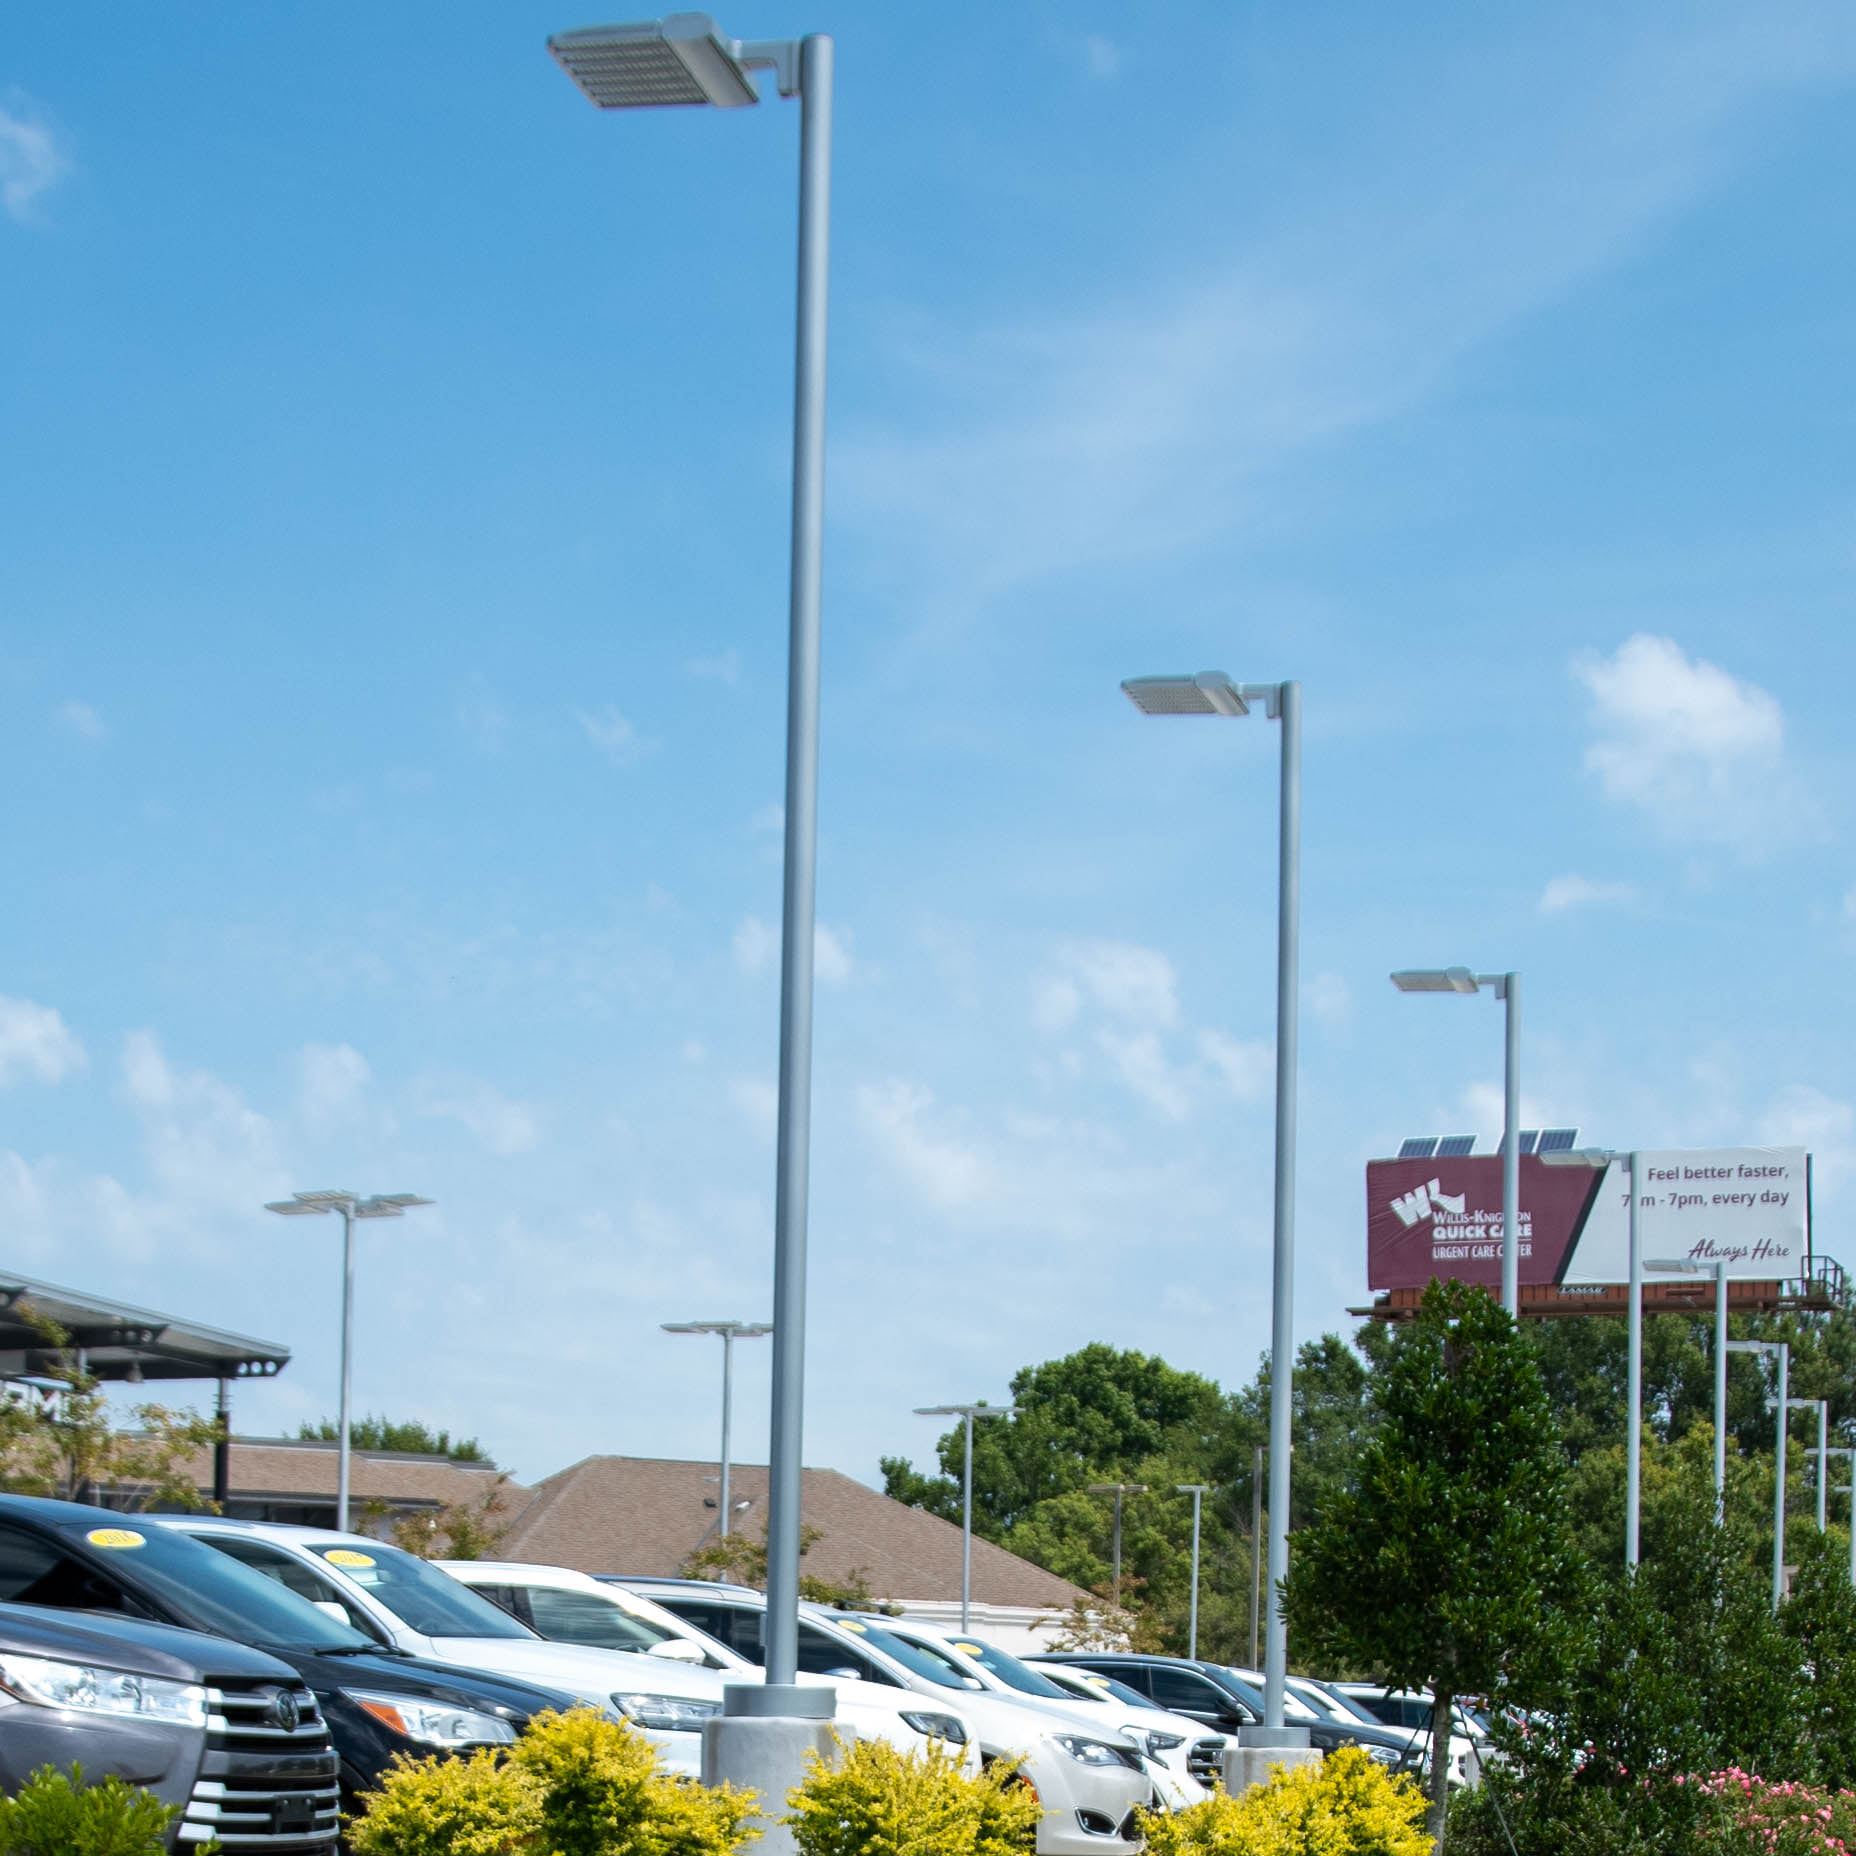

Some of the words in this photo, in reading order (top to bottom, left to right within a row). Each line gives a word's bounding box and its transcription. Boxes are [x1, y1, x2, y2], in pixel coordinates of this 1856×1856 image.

[1647, 1166, 1680, 1181] Feel
[1683, 1165, 1734, 1180] better
[1737, 1163, 1789, 1179] faster,
[1621, 1194, 1656, 1207] 7m
[1668, 1192, 1708, 1208] 7pm,
[1712, 1191, 1757, 1208] every
[1760, 1189, 1790, 1207] day
[1432, 1225, 1487, 1240] QUICK
[1432, 1245, 1470, 1259] URGENT
[1471, 1244, 1496, 1258] CARE
[1496, 1243, 1533, 1257] CER
[1688, 1238, 1749, 1262] Always
[1751, 1238, 1791, 1260] Here
